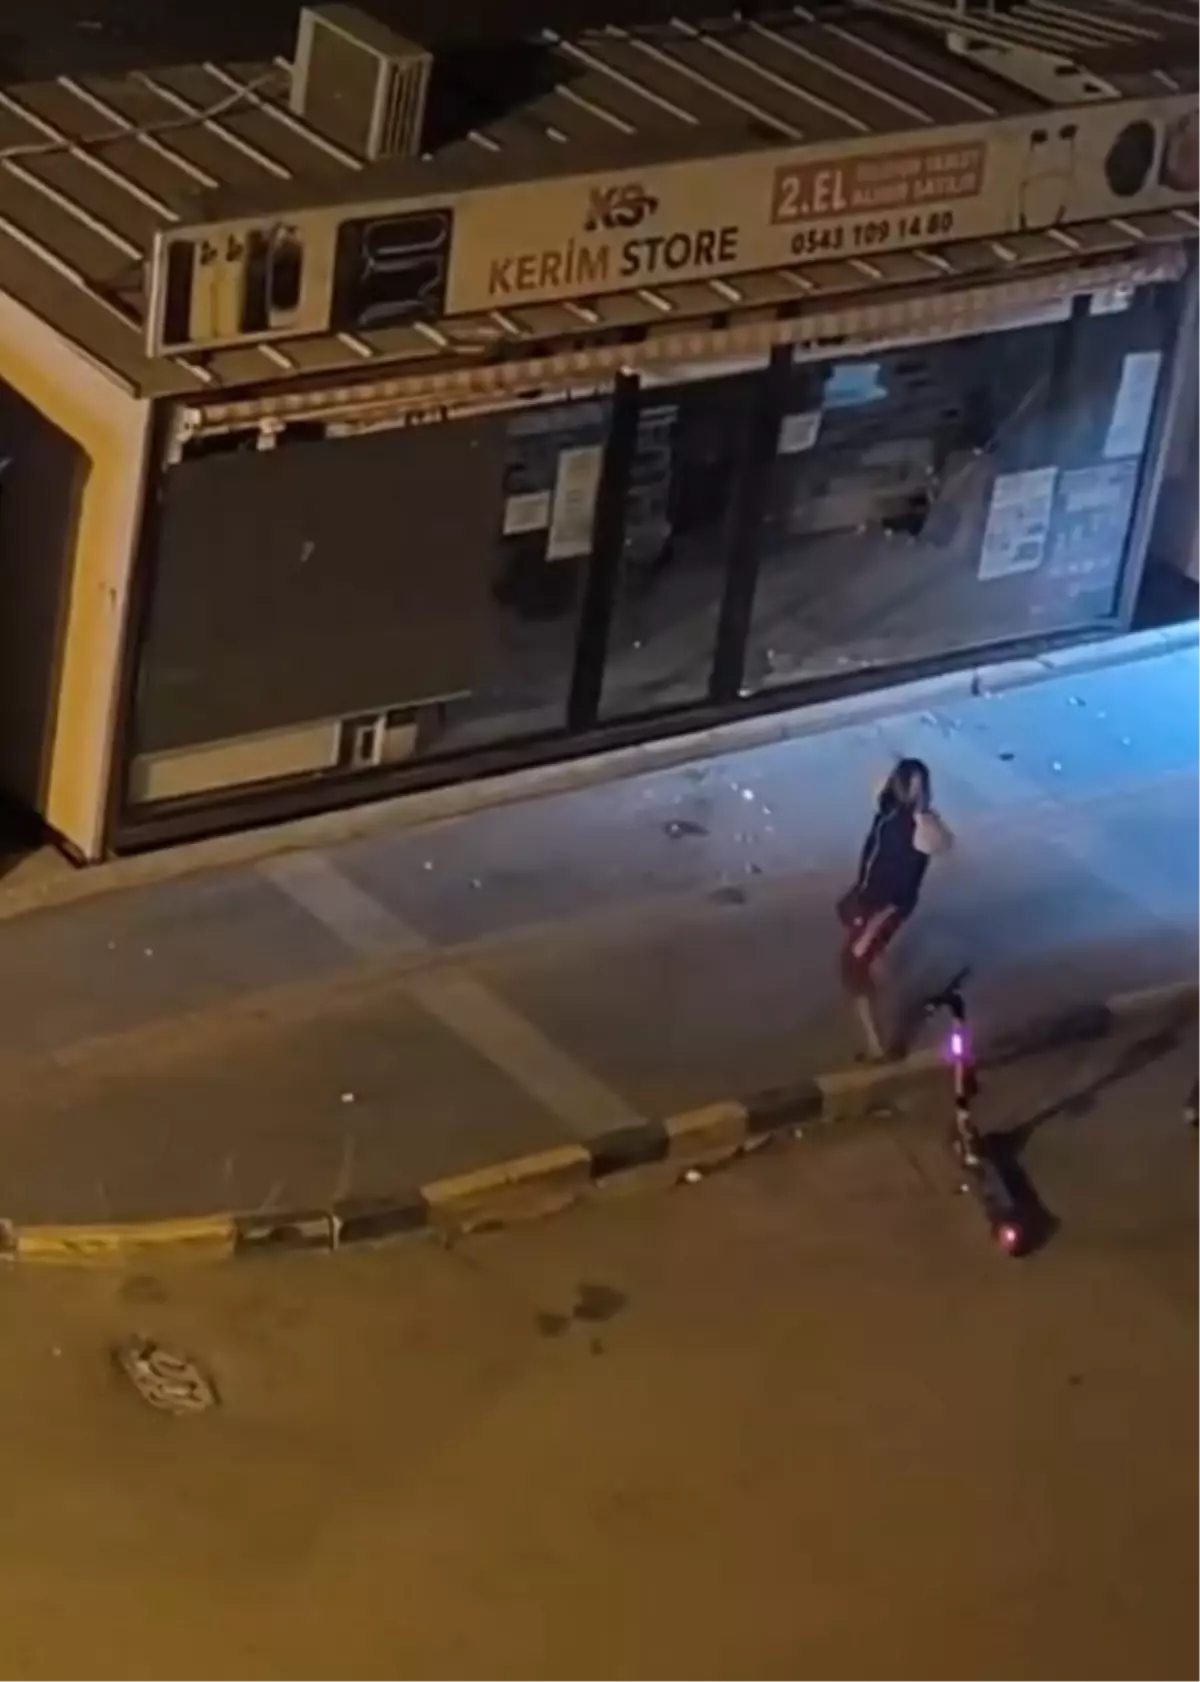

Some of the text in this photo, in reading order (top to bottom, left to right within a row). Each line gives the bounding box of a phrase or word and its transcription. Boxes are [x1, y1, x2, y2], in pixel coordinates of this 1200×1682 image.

[779, 169, 847, 216] 2.EL
[853, 219, 890, 246] 109
[897, 213, 921, 240] 14
[489, 226, 739, 294] KERİM STORE
